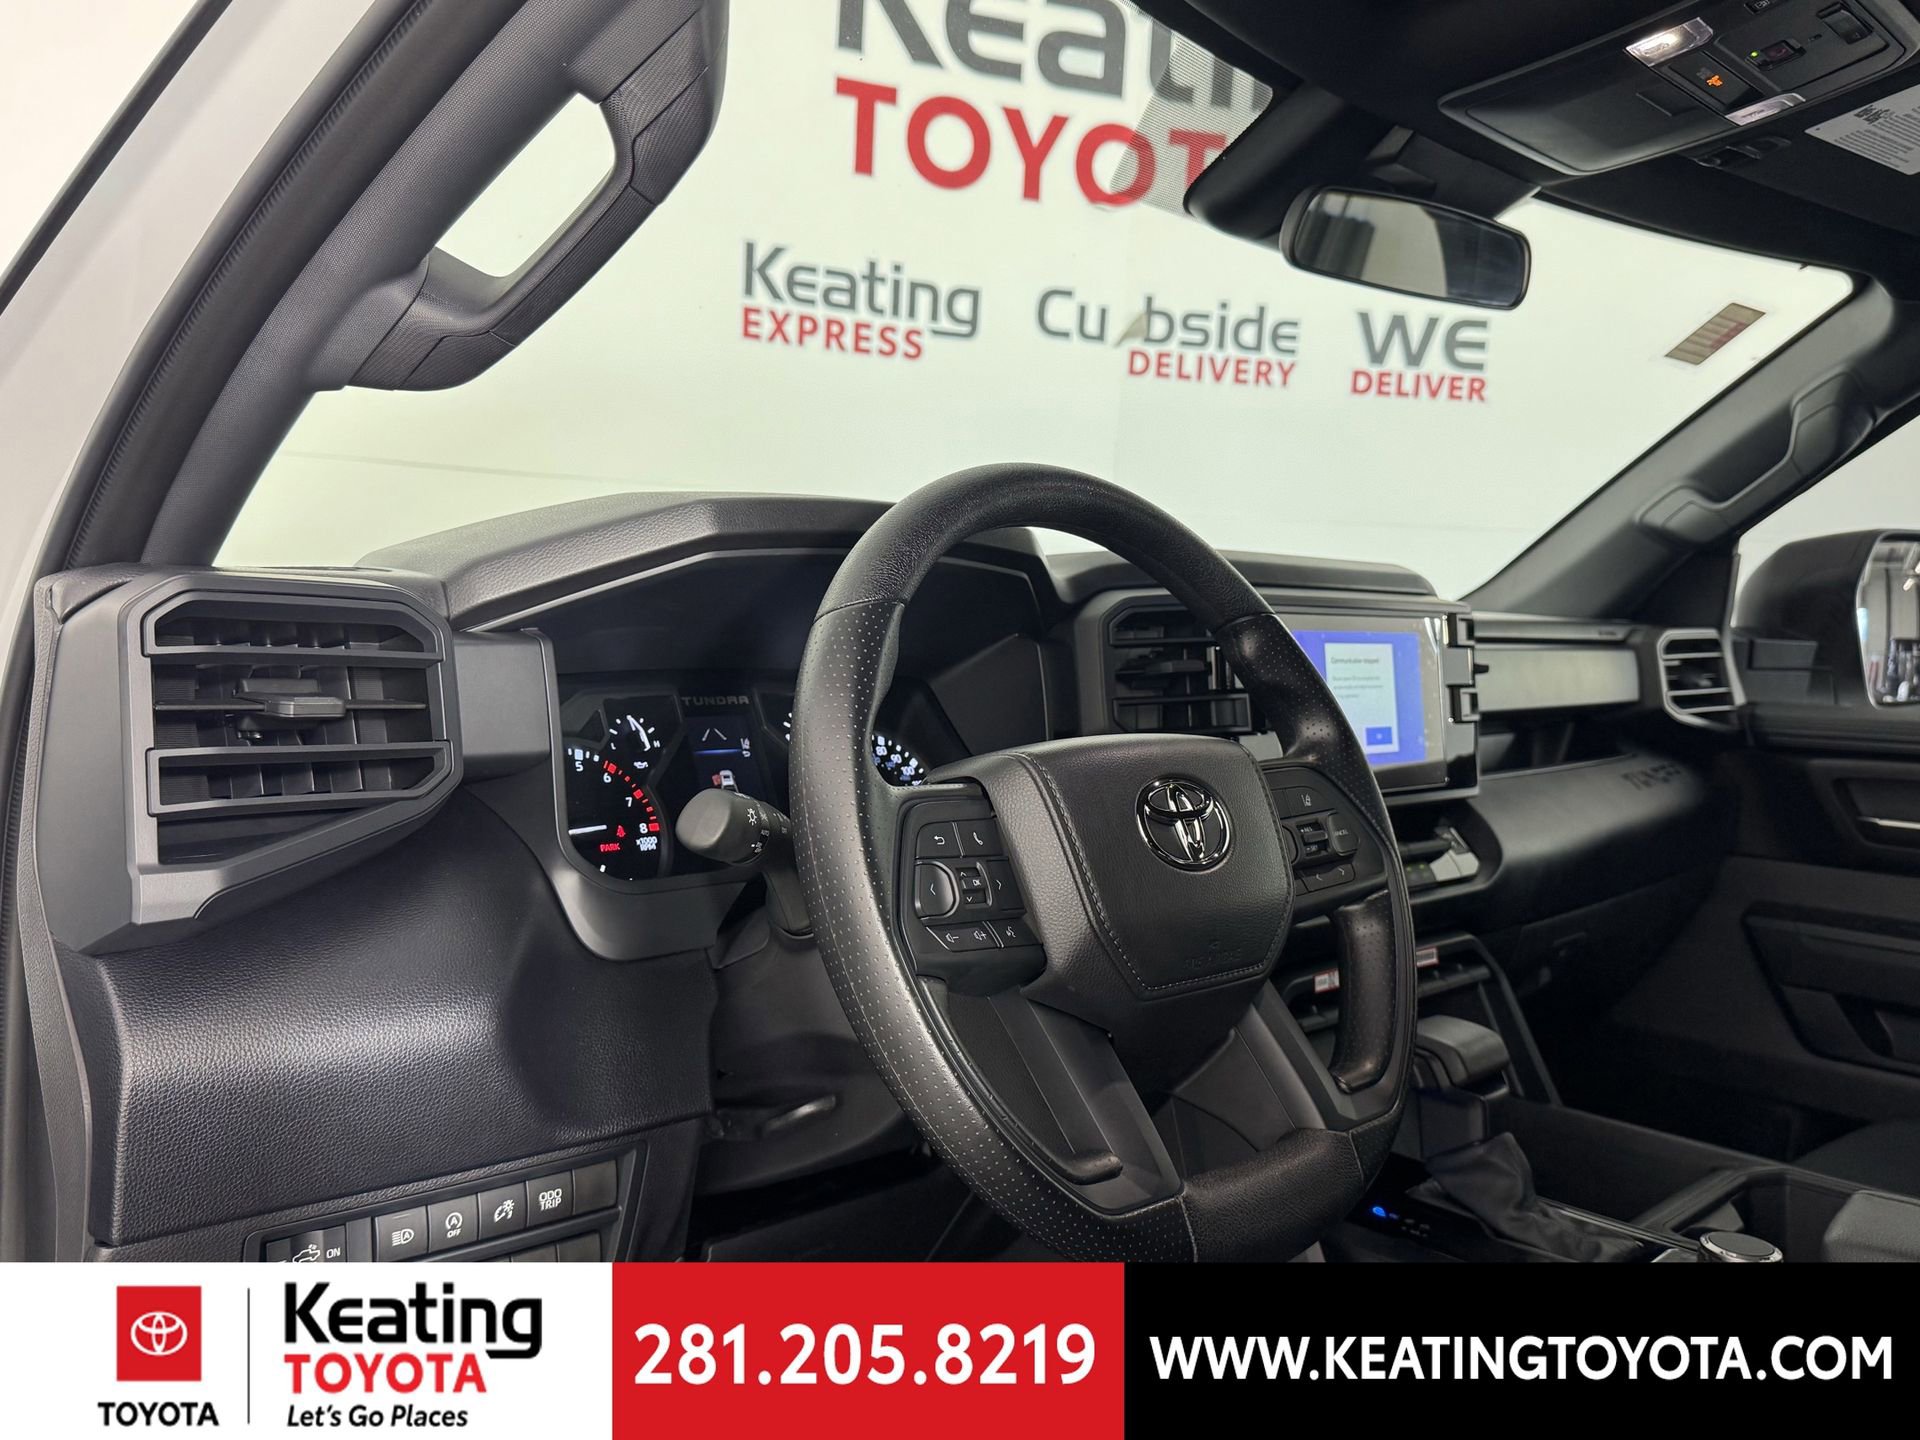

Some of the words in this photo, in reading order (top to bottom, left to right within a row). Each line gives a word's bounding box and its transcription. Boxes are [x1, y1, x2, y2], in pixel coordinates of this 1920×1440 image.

[835, 77, 1227, 207] TOYOT
[743, 241, 980, 339] Keating
[1037, 288, 1299, 354] Cubside
[742, 307, 923, 359] EXPRESS
[1358, 311, 1489, 371] WE
[1128, 350, 1296, 387] DELIVERY
[1352, 369, 1486, 401] DELIVER
[680, 695, 750, 706] TUNDRA
[875, 746, 888, 756] 80
[890, 753, 902, 764] 90
[575, 761, 583, 772] 5
[900, 765, 916, 776] 100
[603, 772, 612, 783] 6
[625, 797, 632, 807] 7
[639, 823, 648, 834] 8
[600, 843, 621, 852] PARK
[538, 1188, 563, 1200] ODO
[539, 1198, 562, 1211] TRIP
[446, 1228, 462, 1239] OFF
[326, 1247, 341, 1259] ON
